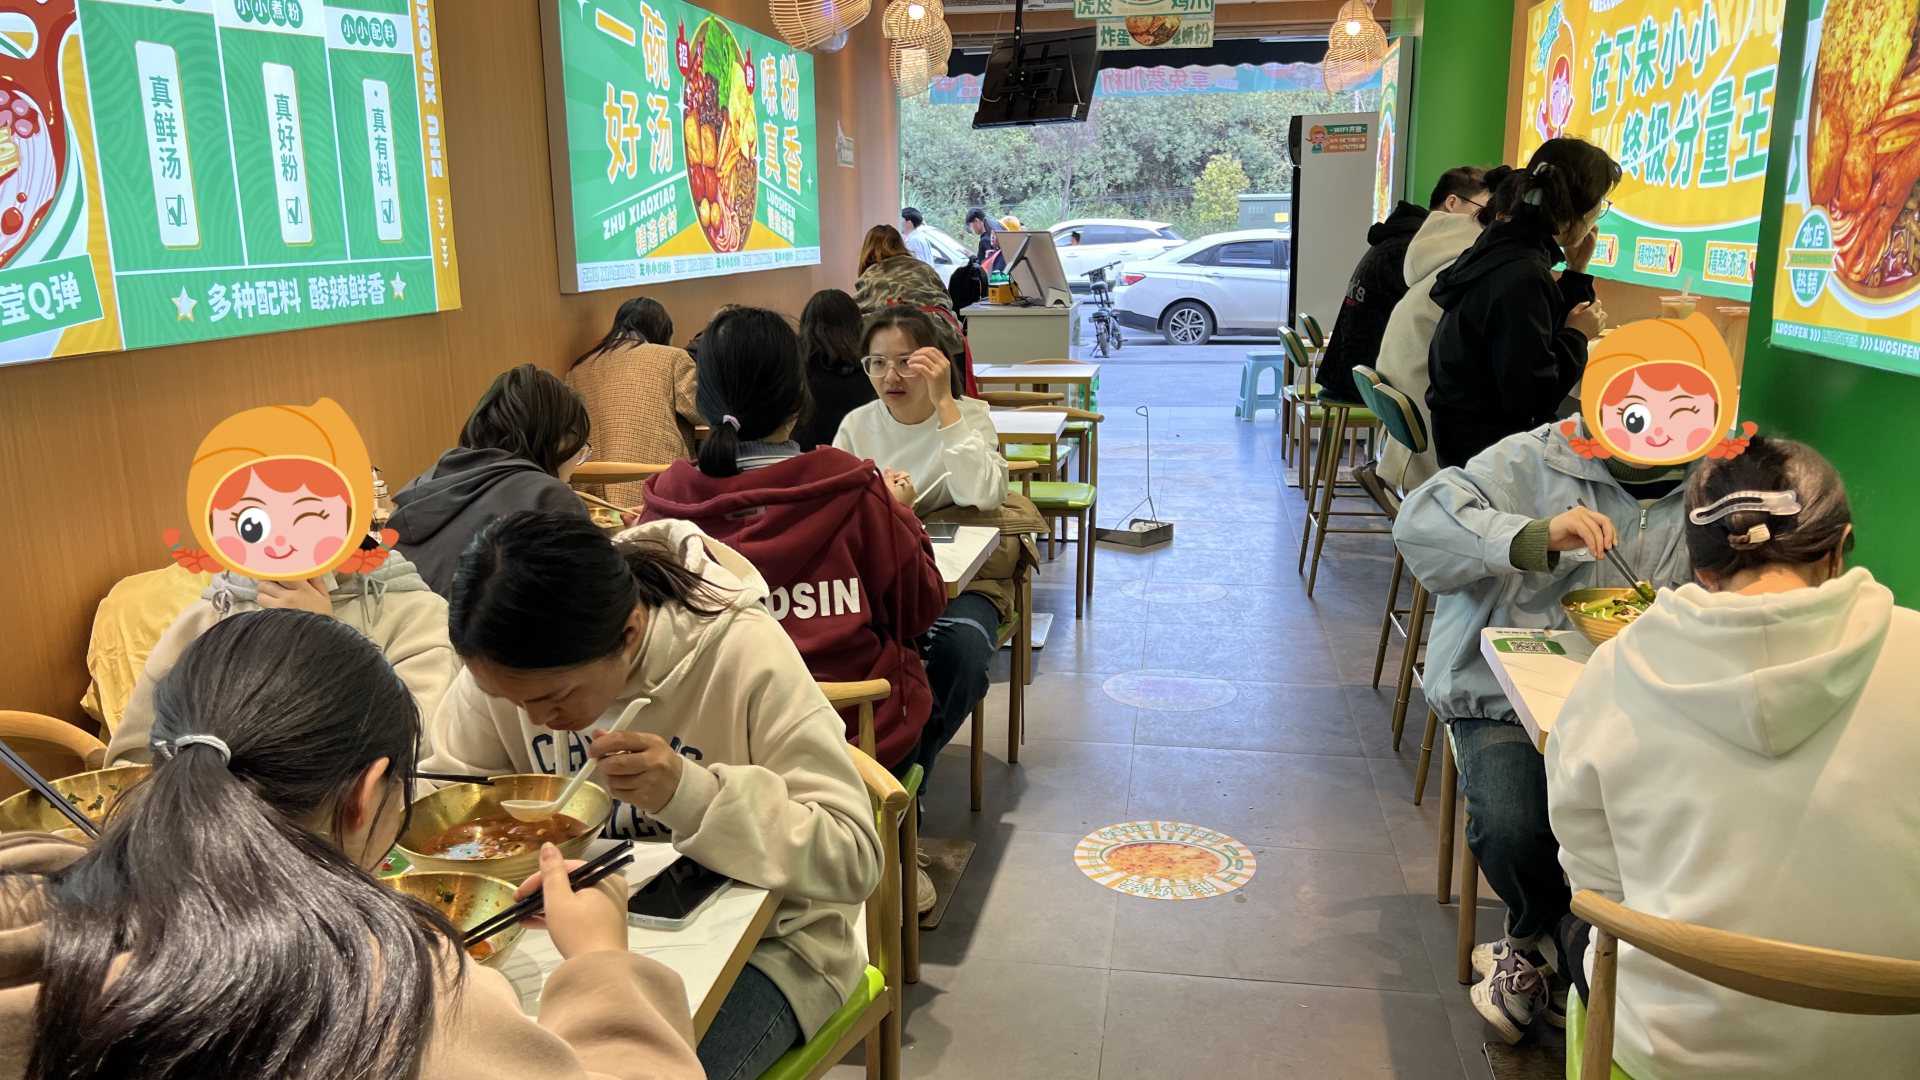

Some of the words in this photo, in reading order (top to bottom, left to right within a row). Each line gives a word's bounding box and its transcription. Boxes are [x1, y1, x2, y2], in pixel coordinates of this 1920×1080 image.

[236, 0, 301, 22] 小小煮粉
[342, 17, 396, 43] 小小配料
[1101, 25, 1131, 47] 炸蛋
[596, 4, 671, 91] 一碗
[678, 42, 689, 69] 招
[1591, 1, 1719, 114] 在下朱小小
[760, 52, 800, 122] 嗦粉
[148, 75, 182, 180] 真鲜汤
[274, 94, 299, 183] 真好粉
[371, 108, 392, 188] 真有料
[426, 114, 444, 178] ZHU
[603, 83, 673, 184] 好汤
[1621, 64, 1778, 189] 终极分量王
[763, 121, 803, 195] 真香
[602, 211, 626, 240] ZHU
[628, 184, 676, 226] XIAOXIAO
[766, 187, 796, 221] LUOSIFEN
[1801, 222, 1826, 247] 本店
[207, 280, 301, 322] 多种配料
[308, 273, 386, 311] 酸辣鲜香
[1796, 271, 1820, 295] 热销
[1775, 321, 1809, 339] LUOSIFEN
[1873, 337, 1920, 361] LUOSIFEN
